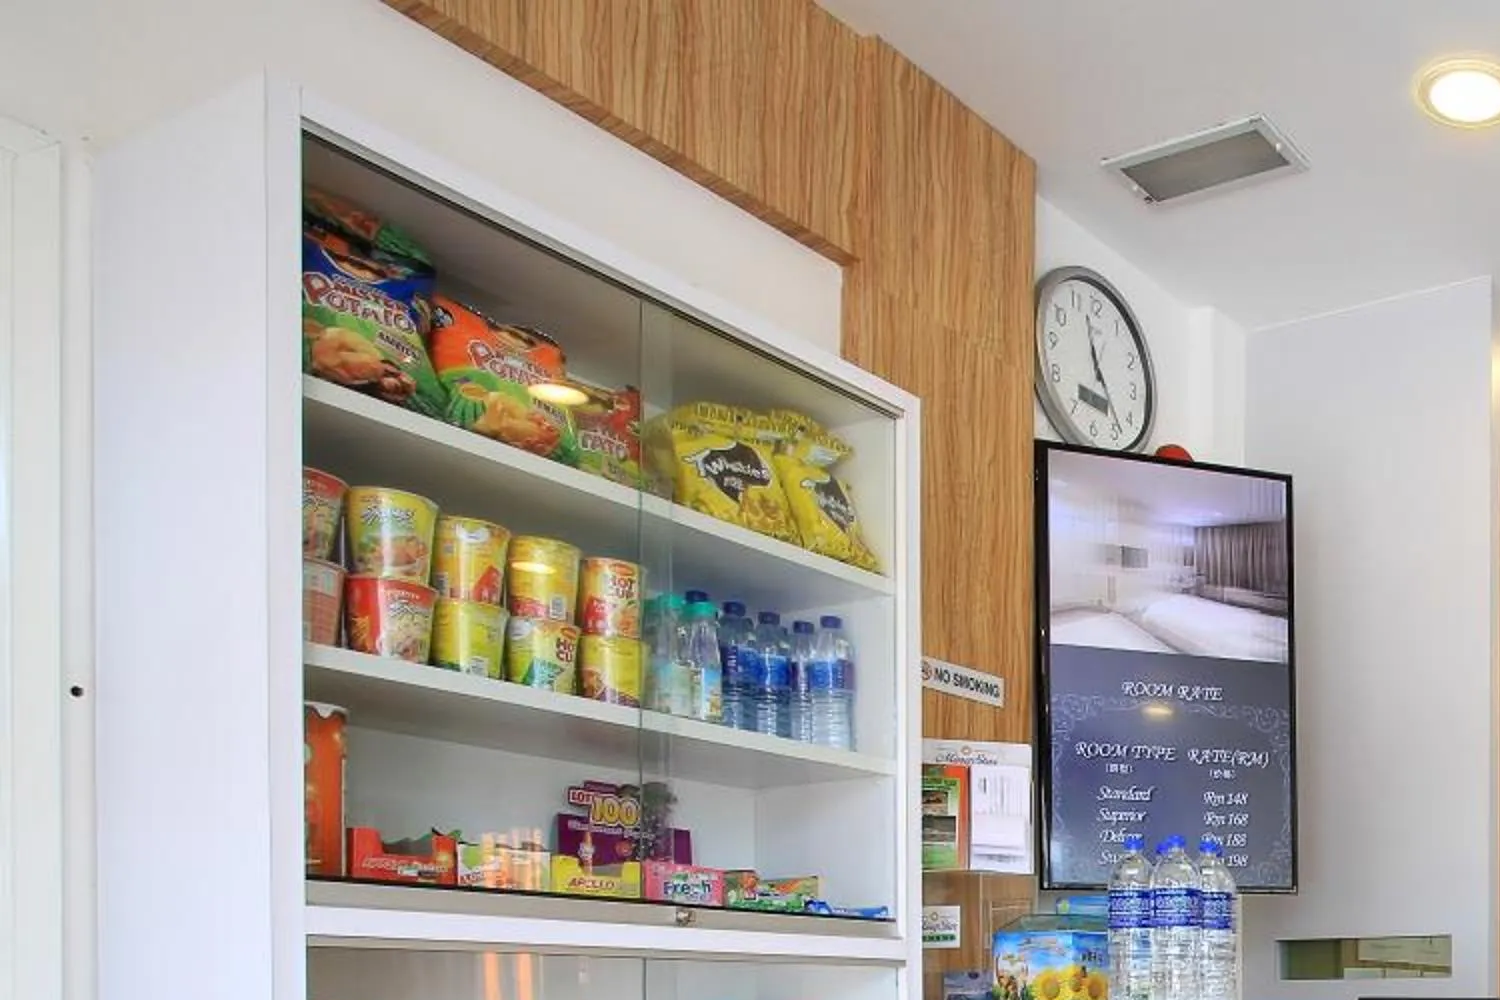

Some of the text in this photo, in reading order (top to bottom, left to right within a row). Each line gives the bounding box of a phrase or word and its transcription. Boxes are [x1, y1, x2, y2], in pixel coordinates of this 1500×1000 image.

[1071, 289, 1082, 313] 11
[1049, 331, 1059, 350] 9
[1127, 352, 1139, 371] 2
[1051, 363, 1062, 383] 8
[1129, 382, 1138, 401] 3
[1070, 398, 1080, 415] 7
[1125, 411, 1134, 427] 4
[1089, 420, 1099, 438] 6
[1110, 423, 1121, 441] 5
[934, 667, 1001, 698] NO SMOKING
[1121, 681, 1224, 701] ROOM RATE
[1074, 741, 1270, 769] ROOM TYPE RATE(RM)
[1096, 785, 1155, 801] Standard
[590, 796, 641, 829] 100
[1096, 807, 1147, 825] Superior
[1227, 812, 1249, 826] 168
[1226, 854, 1249, 868] 198
[567, 877, 616, 890] APOLLO
